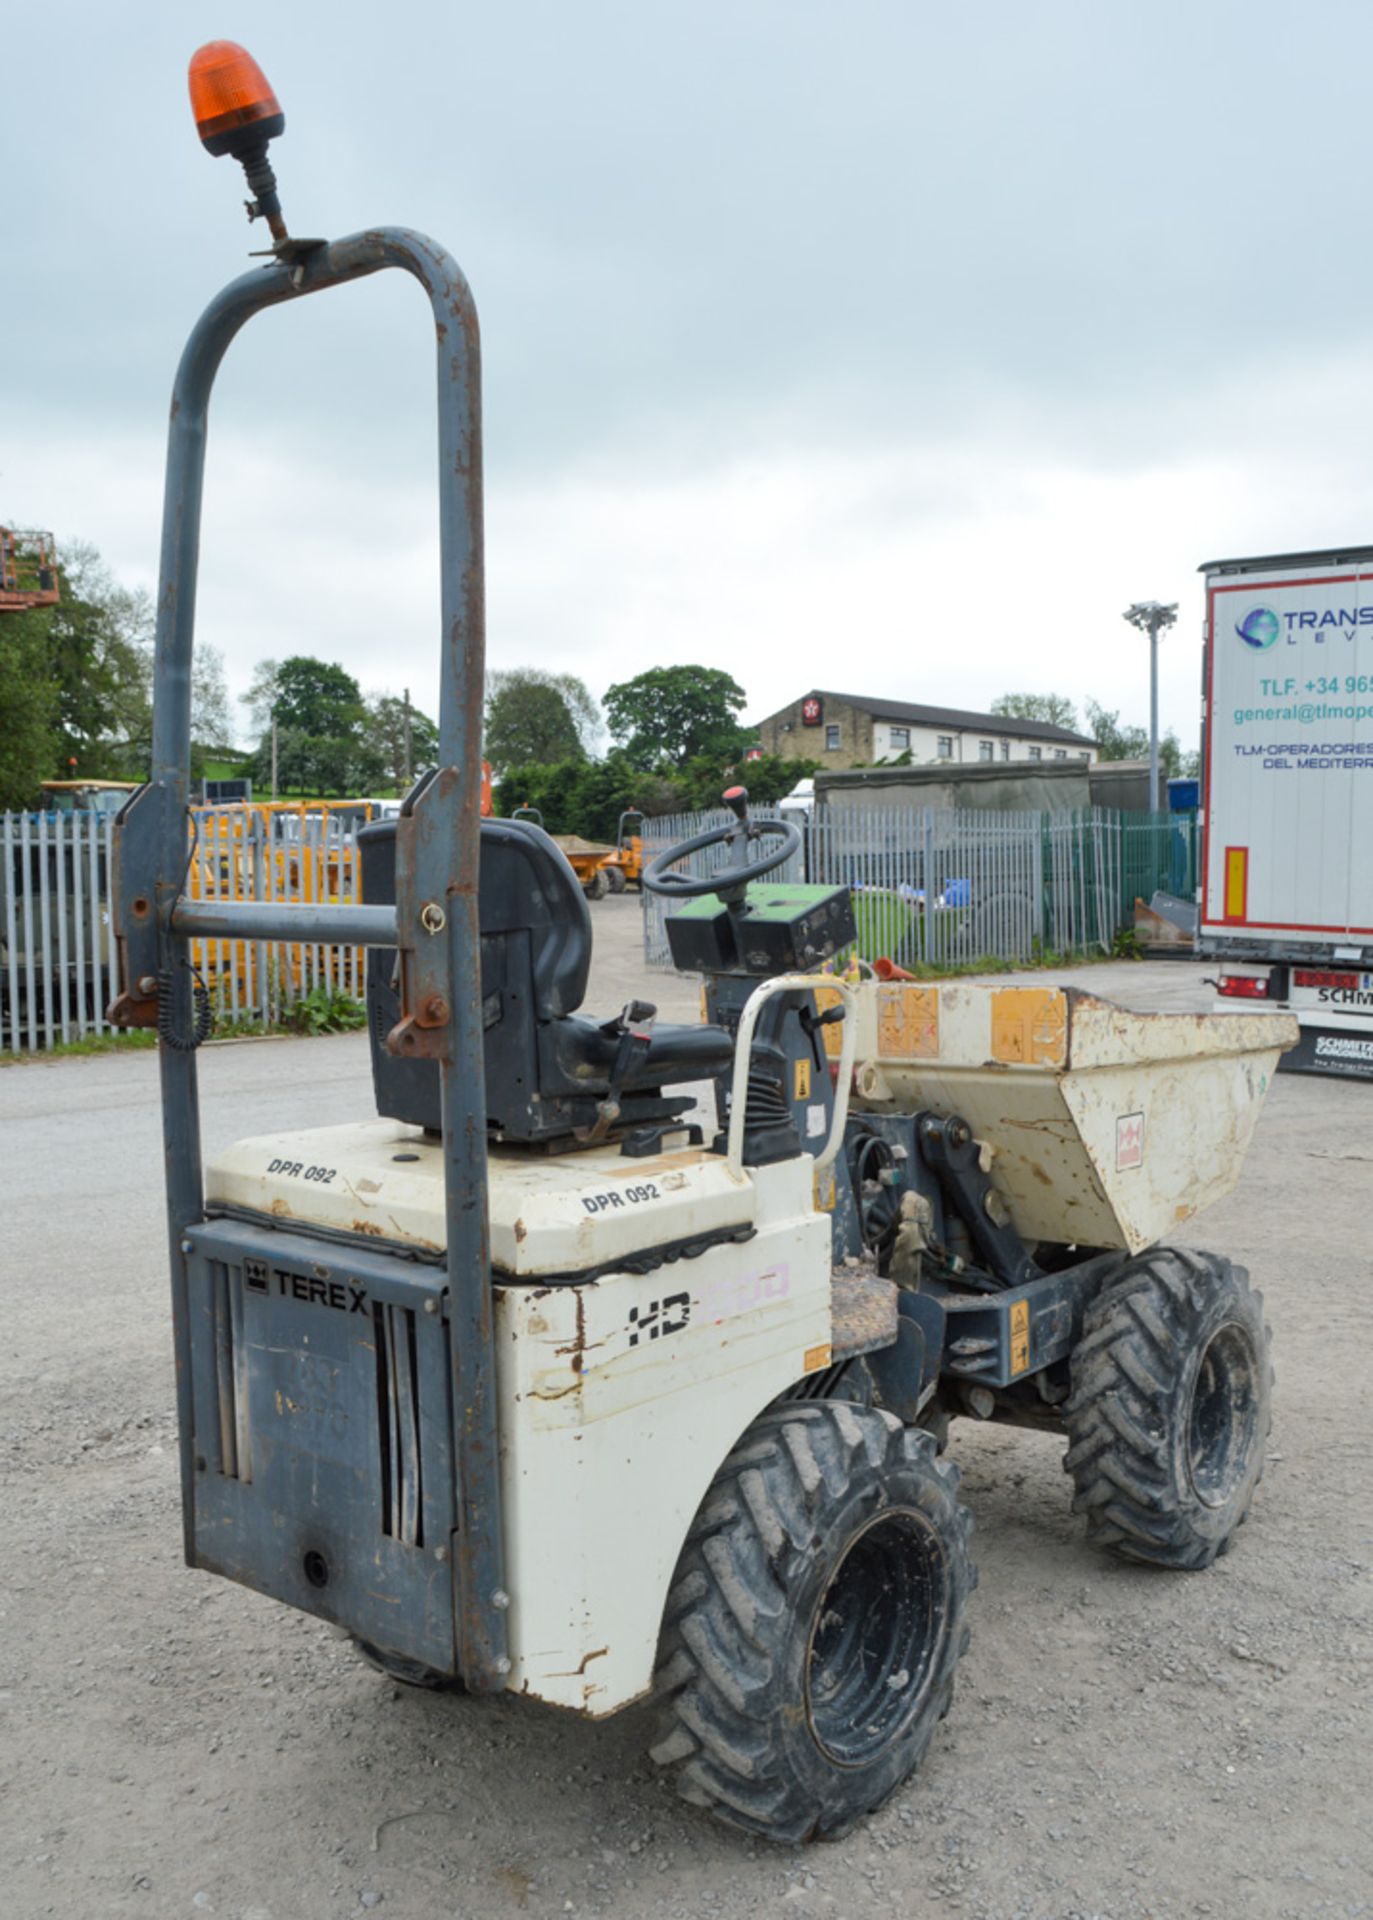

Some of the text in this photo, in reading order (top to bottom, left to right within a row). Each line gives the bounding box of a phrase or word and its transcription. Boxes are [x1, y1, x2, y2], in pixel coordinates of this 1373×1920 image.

[1283, 607, 1373, 629] TRANS
[1287, 630, 1373, 644] LEV
[1260, 678, 1298, 697] TLF.
[1305, 677, 1340, 695] +34
[1263, 758, 1293, 769] DEL
[267, 1159, 337, 1184] DPR 092
[581, 1183, 661, 1213] DPR 092
[274, 1268, 369, 1316] TEREX
[629, 1292, 690, 1347] HD
